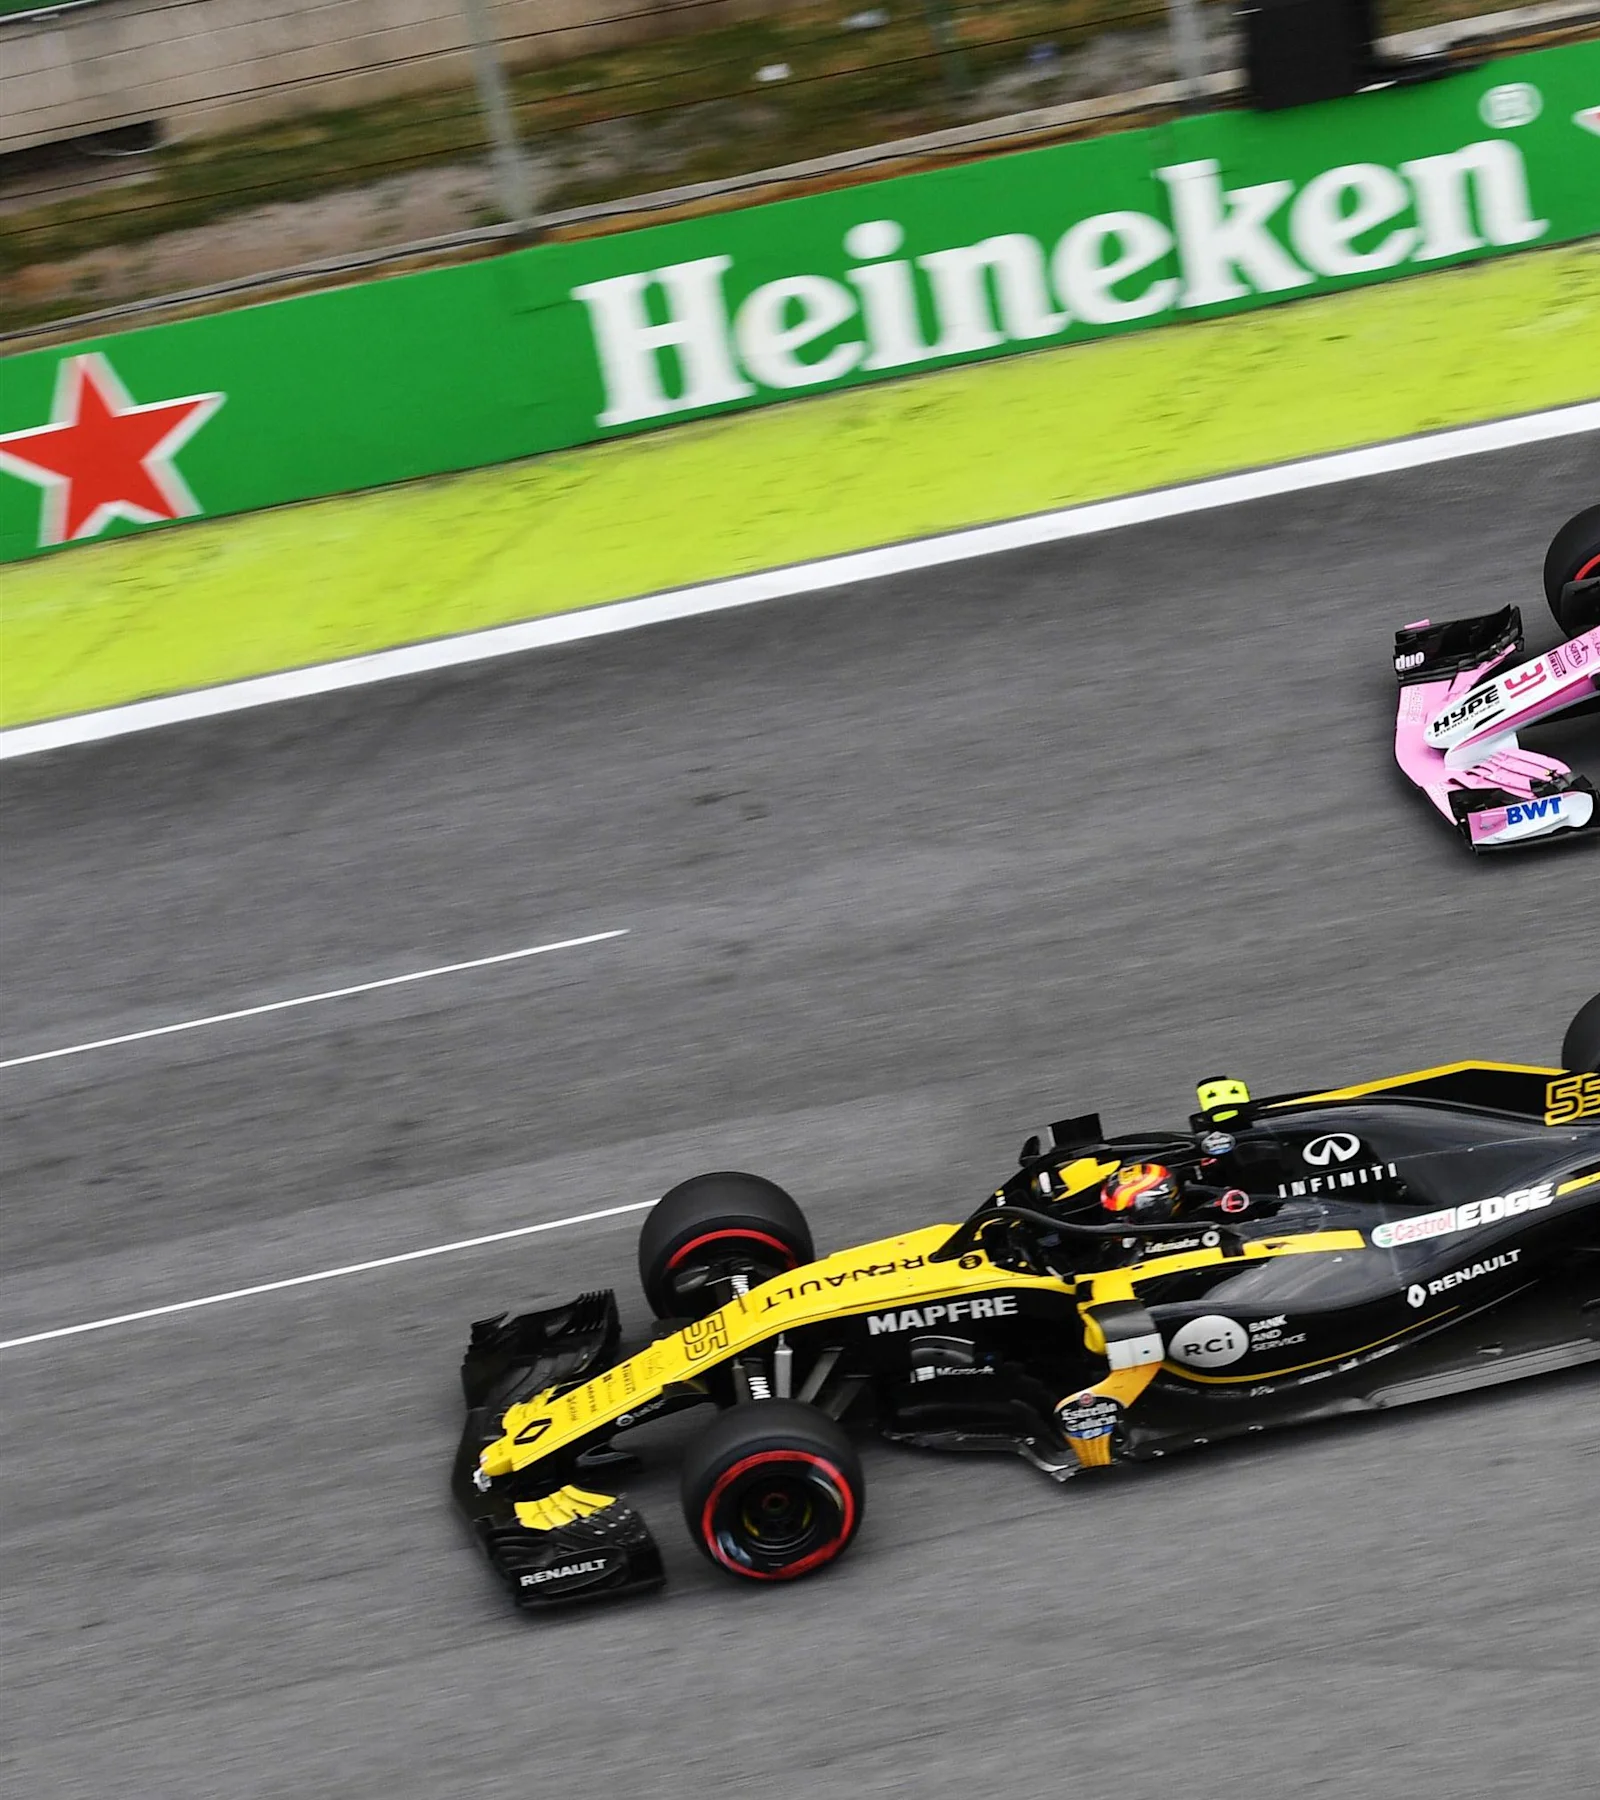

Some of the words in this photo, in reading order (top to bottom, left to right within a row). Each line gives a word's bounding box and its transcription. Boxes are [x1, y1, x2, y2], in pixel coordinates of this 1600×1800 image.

[572, 138, 1549, 429] Heineken
[1395, 651, 1425, 671] duo
[1547, 651, 1567, 678] PIRELLI
[1433, 687, 1500, 733] HYPE
[1506, 796, 1562, 826] BWT
[1278, 1162, 1398, 1199] INFINITI
[1393, 1209, 1454, 1242] Castrol
[1456, 1182, 1557, 1231] EDGE
[761, 1255, 924, 1313] RENAULT
[1429, 1249, 1521, 1295] RENAULT
[867, 1295, 1019, 1335] MAPFRE
[1248, 1313, 1287, 1332] BANK
[681, 1311, 730, 1361] 55
[1183, 1332, 1234, 1356] RCi
[1250, 1329, 1282, 1343] AND
[1250, 1332, 1307, 1352] SERVICE
[519, 1557, 607, 1587] RENAULT
